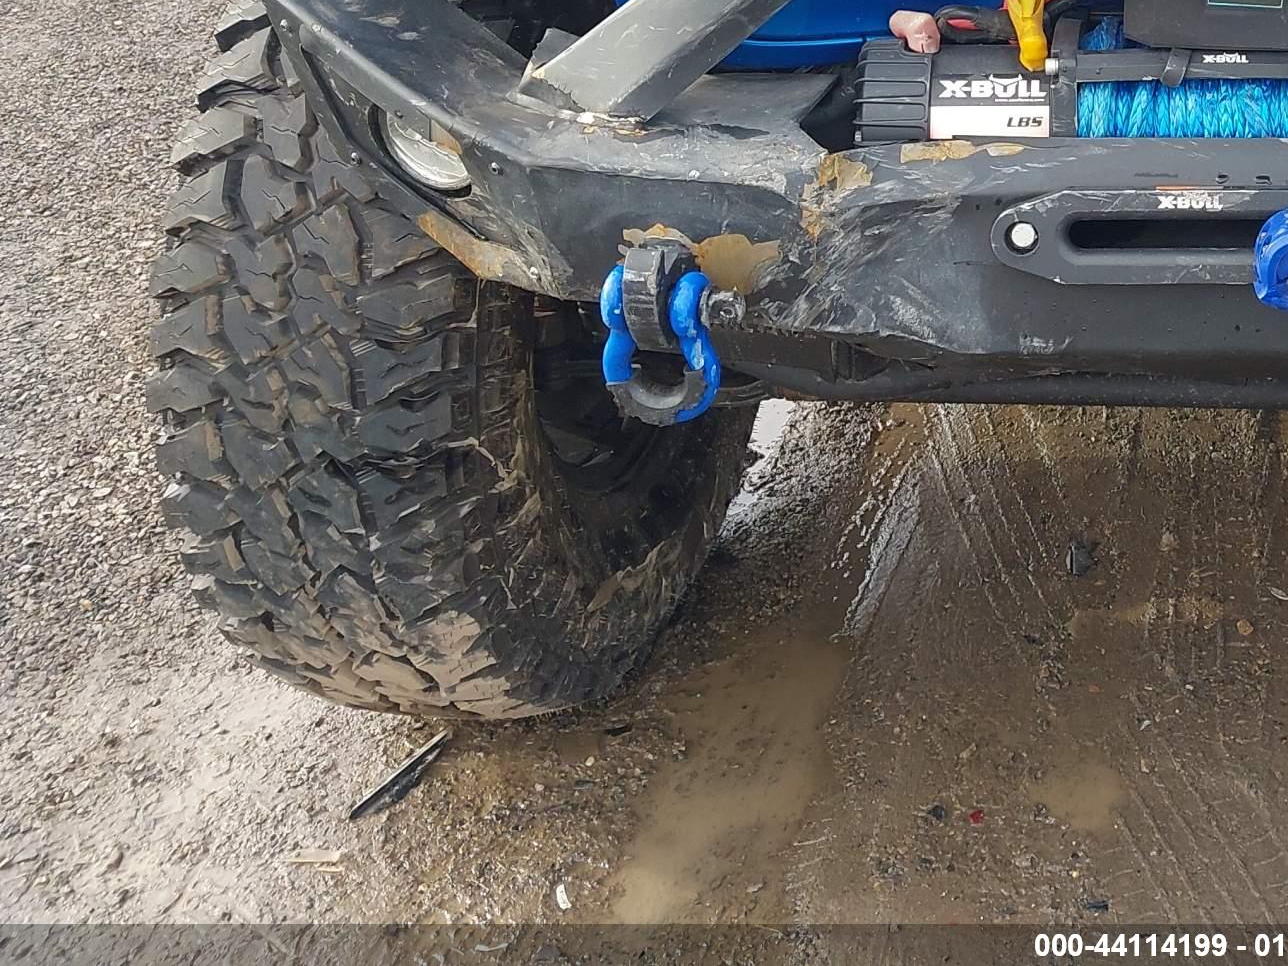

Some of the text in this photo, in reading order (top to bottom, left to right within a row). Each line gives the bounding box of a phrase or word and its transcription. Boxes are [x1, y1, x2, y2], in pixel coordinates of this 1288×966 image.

[1202, 52, 1249, 63] X-BULL
[939, 74, 1048, 98] X-BULL
[1007, 116, 1043, 128] LBS
